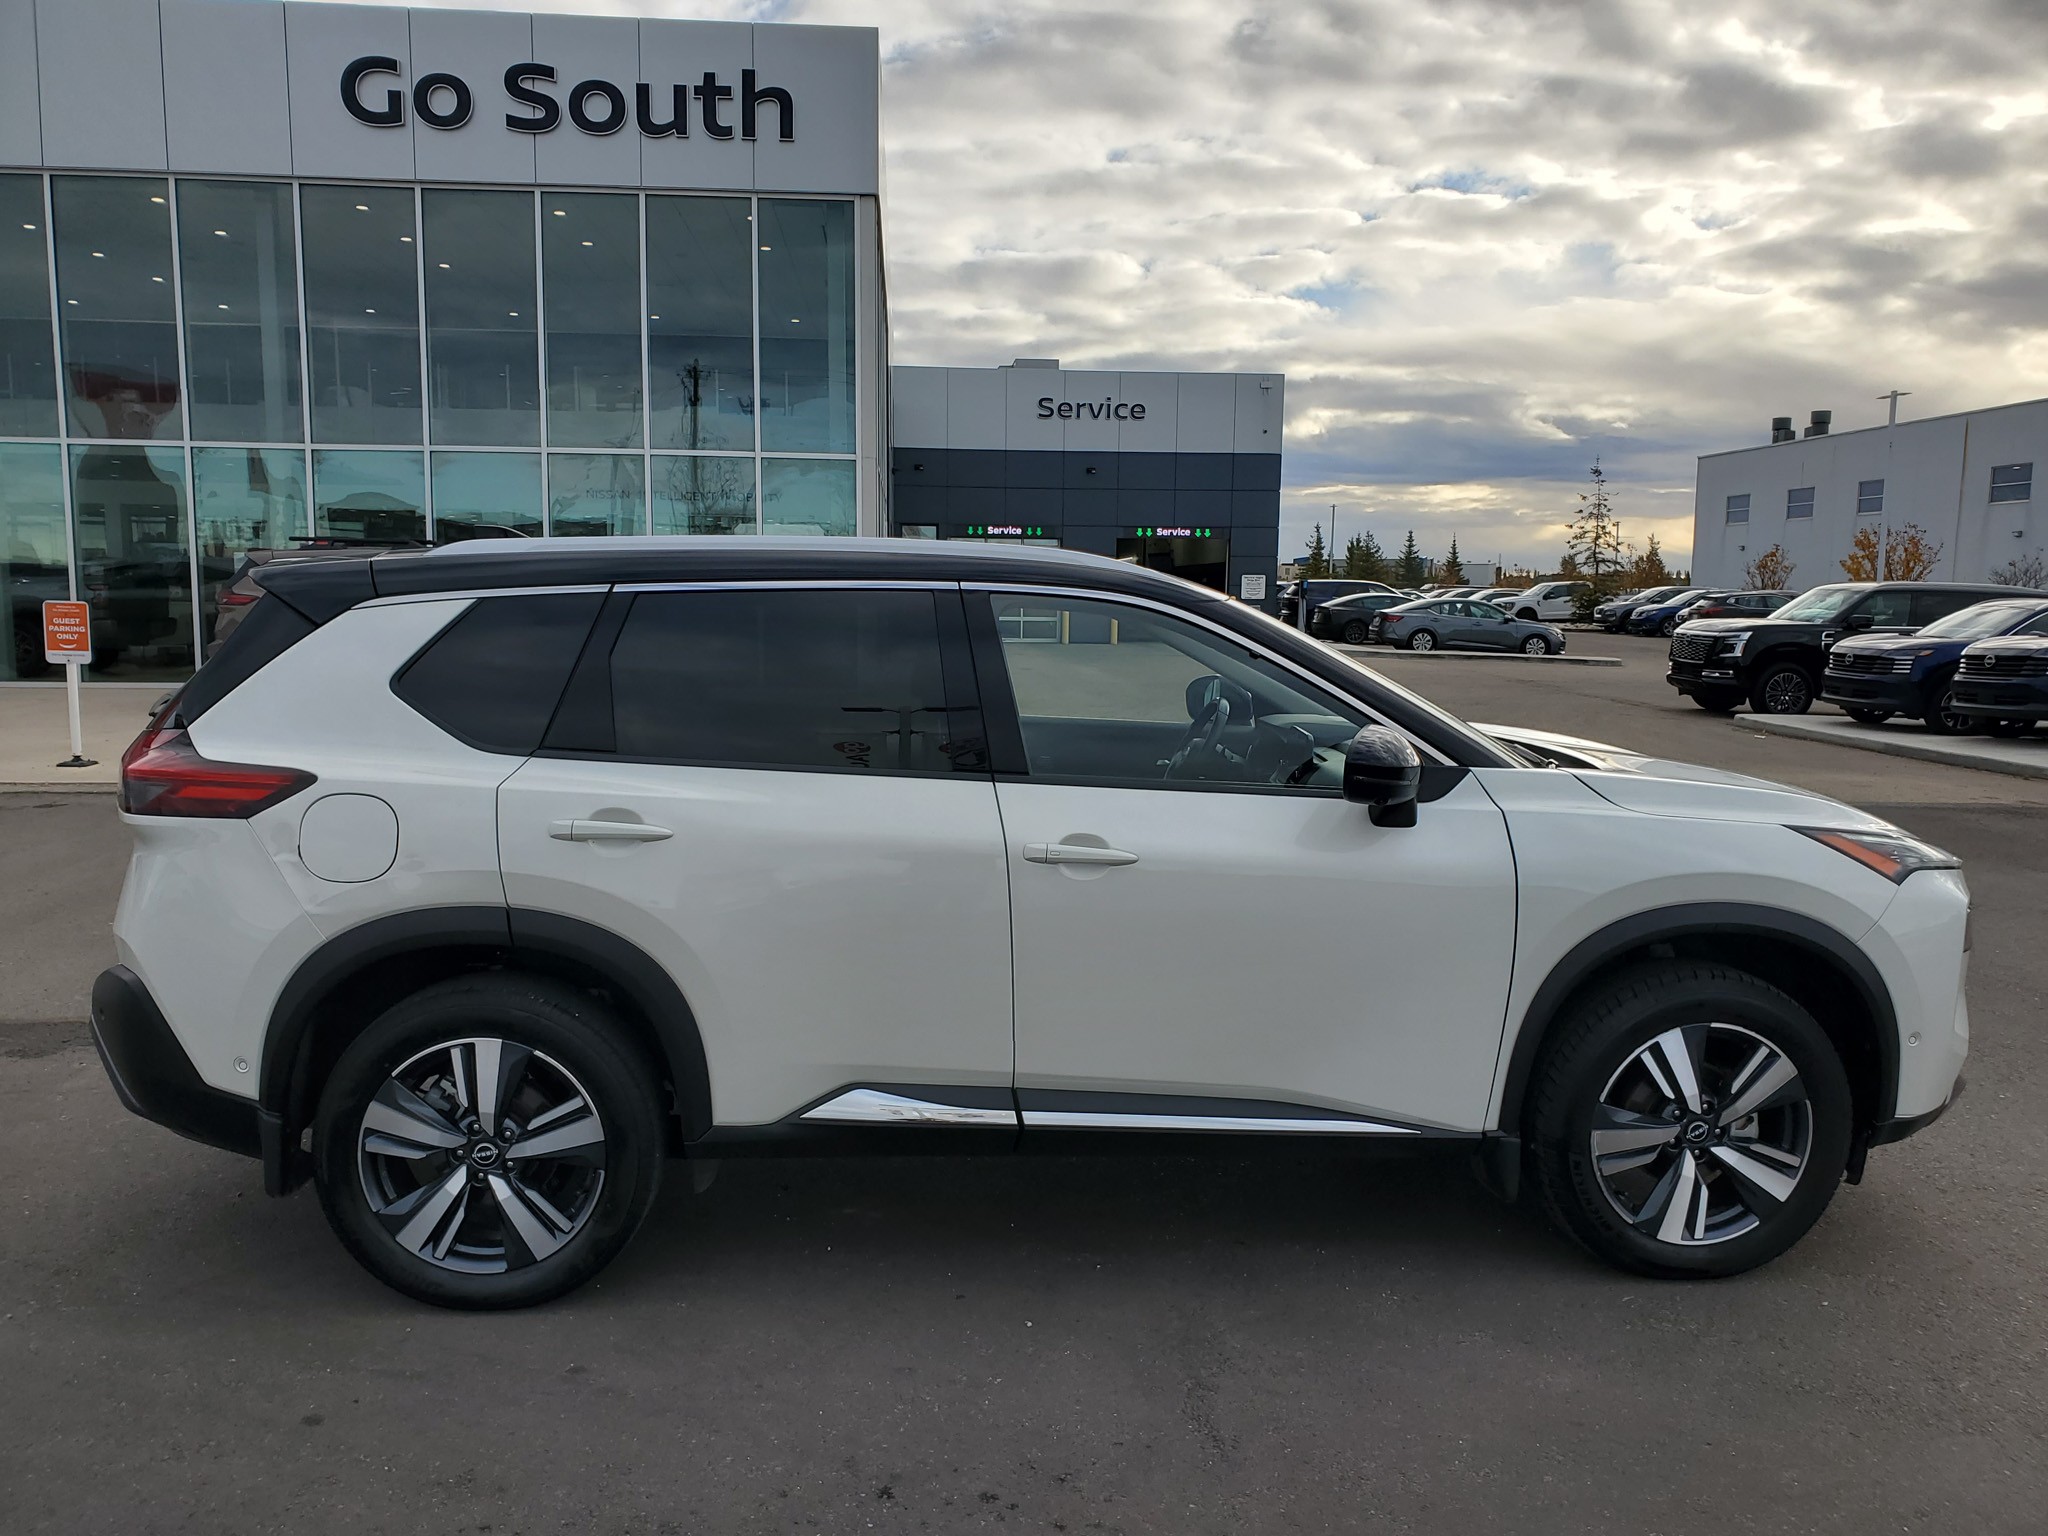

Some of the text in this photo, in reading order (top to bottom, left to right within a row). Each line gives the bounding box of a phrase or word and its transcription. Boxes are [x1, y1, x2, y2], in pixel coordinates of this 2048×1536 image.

[340, 55, 796, 142] Go South
[1038, 396, 1146, 420] Service
[586, 489, 782, 502] NISSAN ITELLIGENT MOBITY
[987, 526, 1022, 535] Service
[1156, 528, 1191, 537] Service
[472, 1148, 499, 1158] NISSAN
